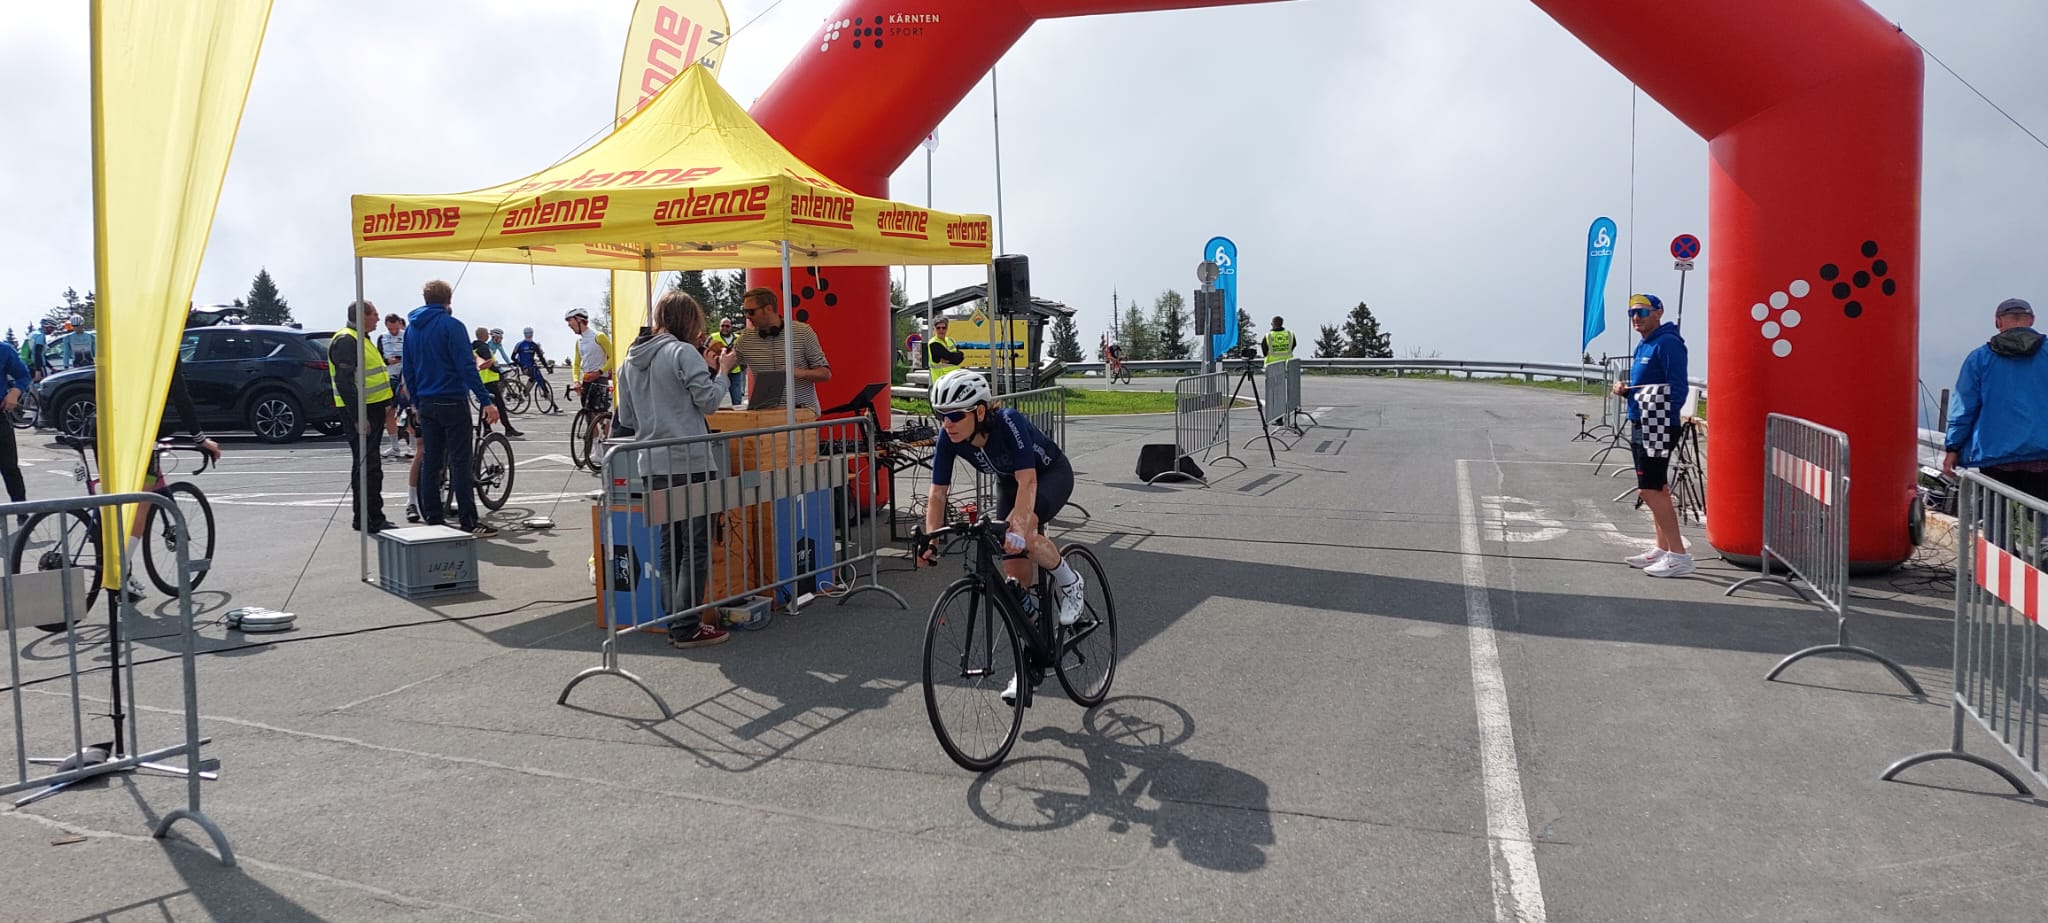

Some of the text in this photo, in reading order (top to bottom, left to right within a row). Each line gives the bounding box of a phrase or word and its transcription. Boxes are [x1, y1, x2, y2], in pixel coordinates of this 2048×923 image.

[889, 12, 940, 24] KÄRNTEN
[890, 27, 923, 37] SPORT
[502, 195, 609, 228] antenne
[653, 184, 770, 221] antenne
[790, 186, 855, 221] antenne
[877, 202, 929, 233] antenne
[363, 203, 461, 234] antenne
[946, 215, 987, 241] antenne
